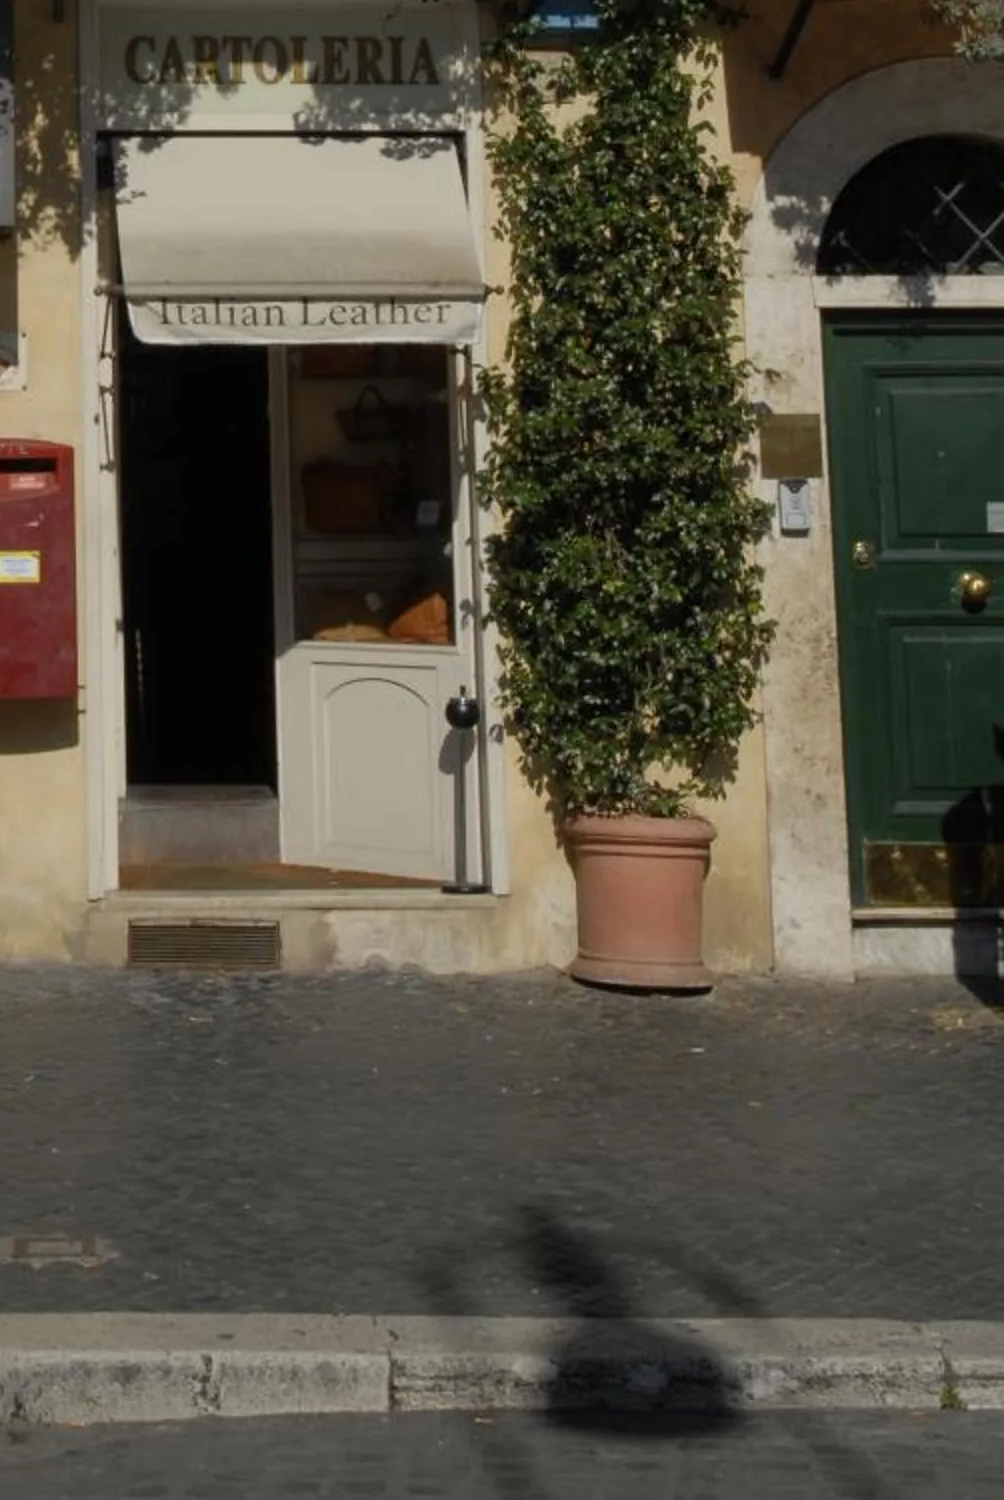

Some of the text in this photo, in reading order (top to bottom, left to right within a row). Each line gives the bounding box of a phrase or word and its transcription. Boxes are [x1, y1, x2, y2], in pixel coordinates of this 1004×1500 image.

[124, 35, 441, 85] CARTOLERIA
[160, 296, 452, 327] Italian Leather
